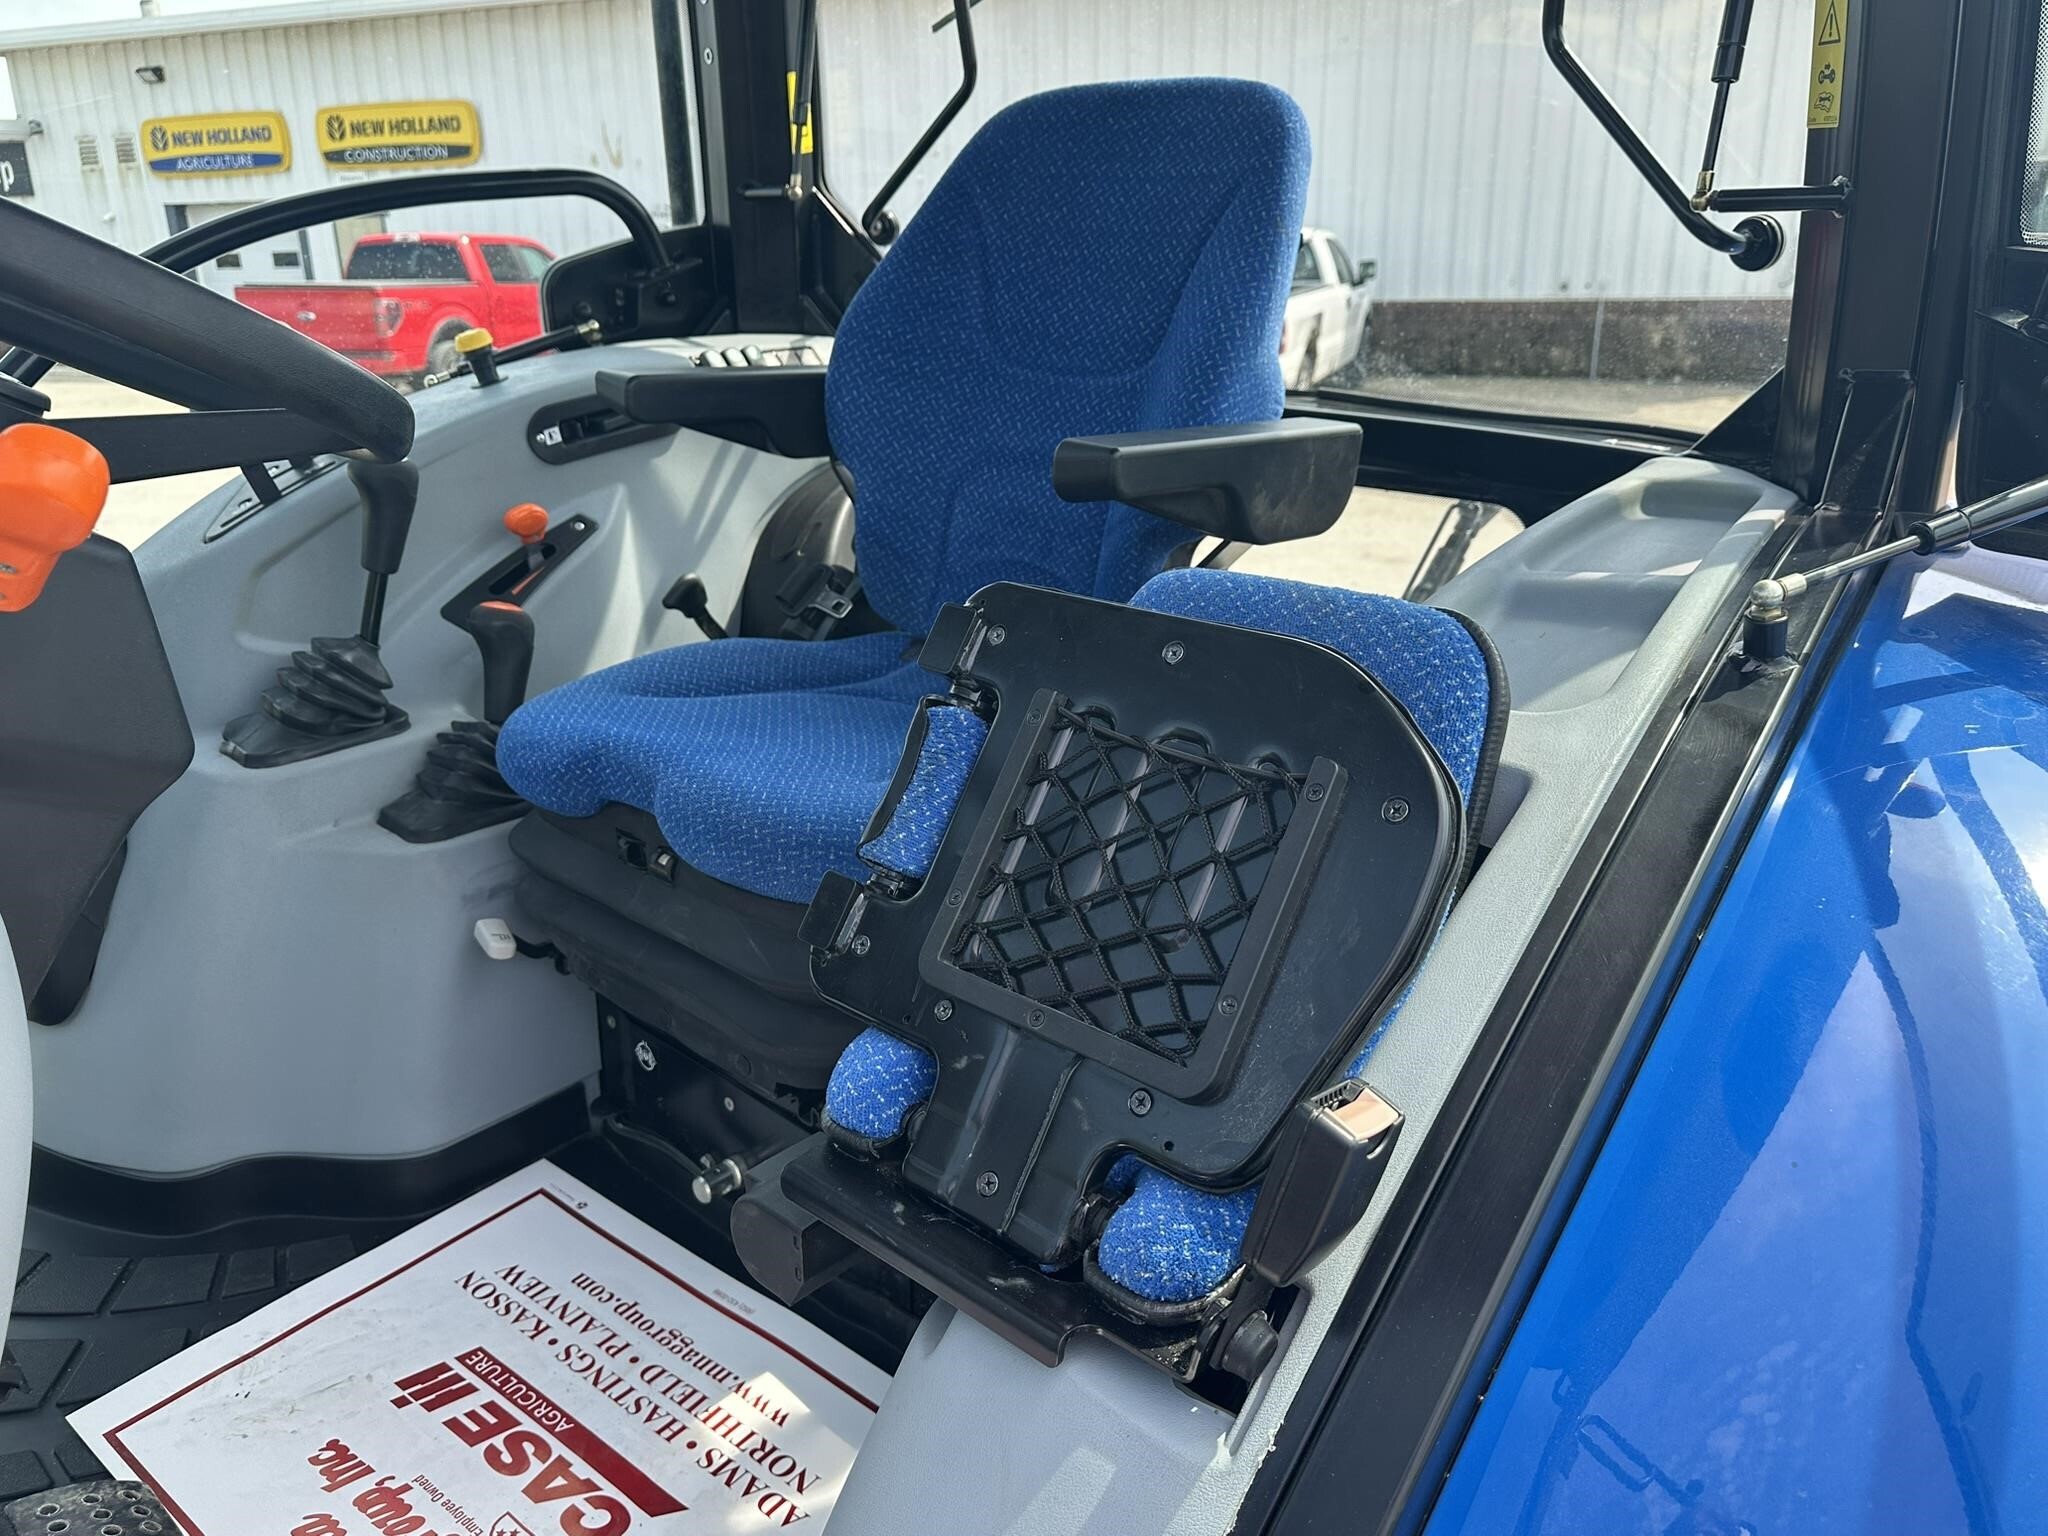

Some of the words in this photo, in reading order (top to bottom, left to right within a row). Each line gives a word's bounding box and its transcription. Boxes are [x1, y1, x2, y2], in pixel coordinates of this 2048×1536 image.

[171, 129, 203, 147] NEW
[207, 125, 272, 146] HOLLAND
[176, 154, 254, 172] AGRICULTURE
[344, 144, 449, 163] CONSTRUCTION
[350, 118, 385, 137] NEW
[389, 115, 462, 135] HOLLAND
[454, 1270, 552, 1341] KASSON
[495, 1264, 632, 1359] PLAINVIEW
[571, 1272, 790, 1428] www.mnaggroup.com
[465, 1350, 575, 1433] AGRICULTURE
[555, 1343, 690, 1444] HASTINGS
[639, 1363, 822, 1496] NORTHFIELD
[411, 1474, 445, 1503] Owned
[441, 1399, 631, 1536] CASE
[696, 1447, 811, 1528] ADAMS
[440, 1498, 484, 1536] Employee
